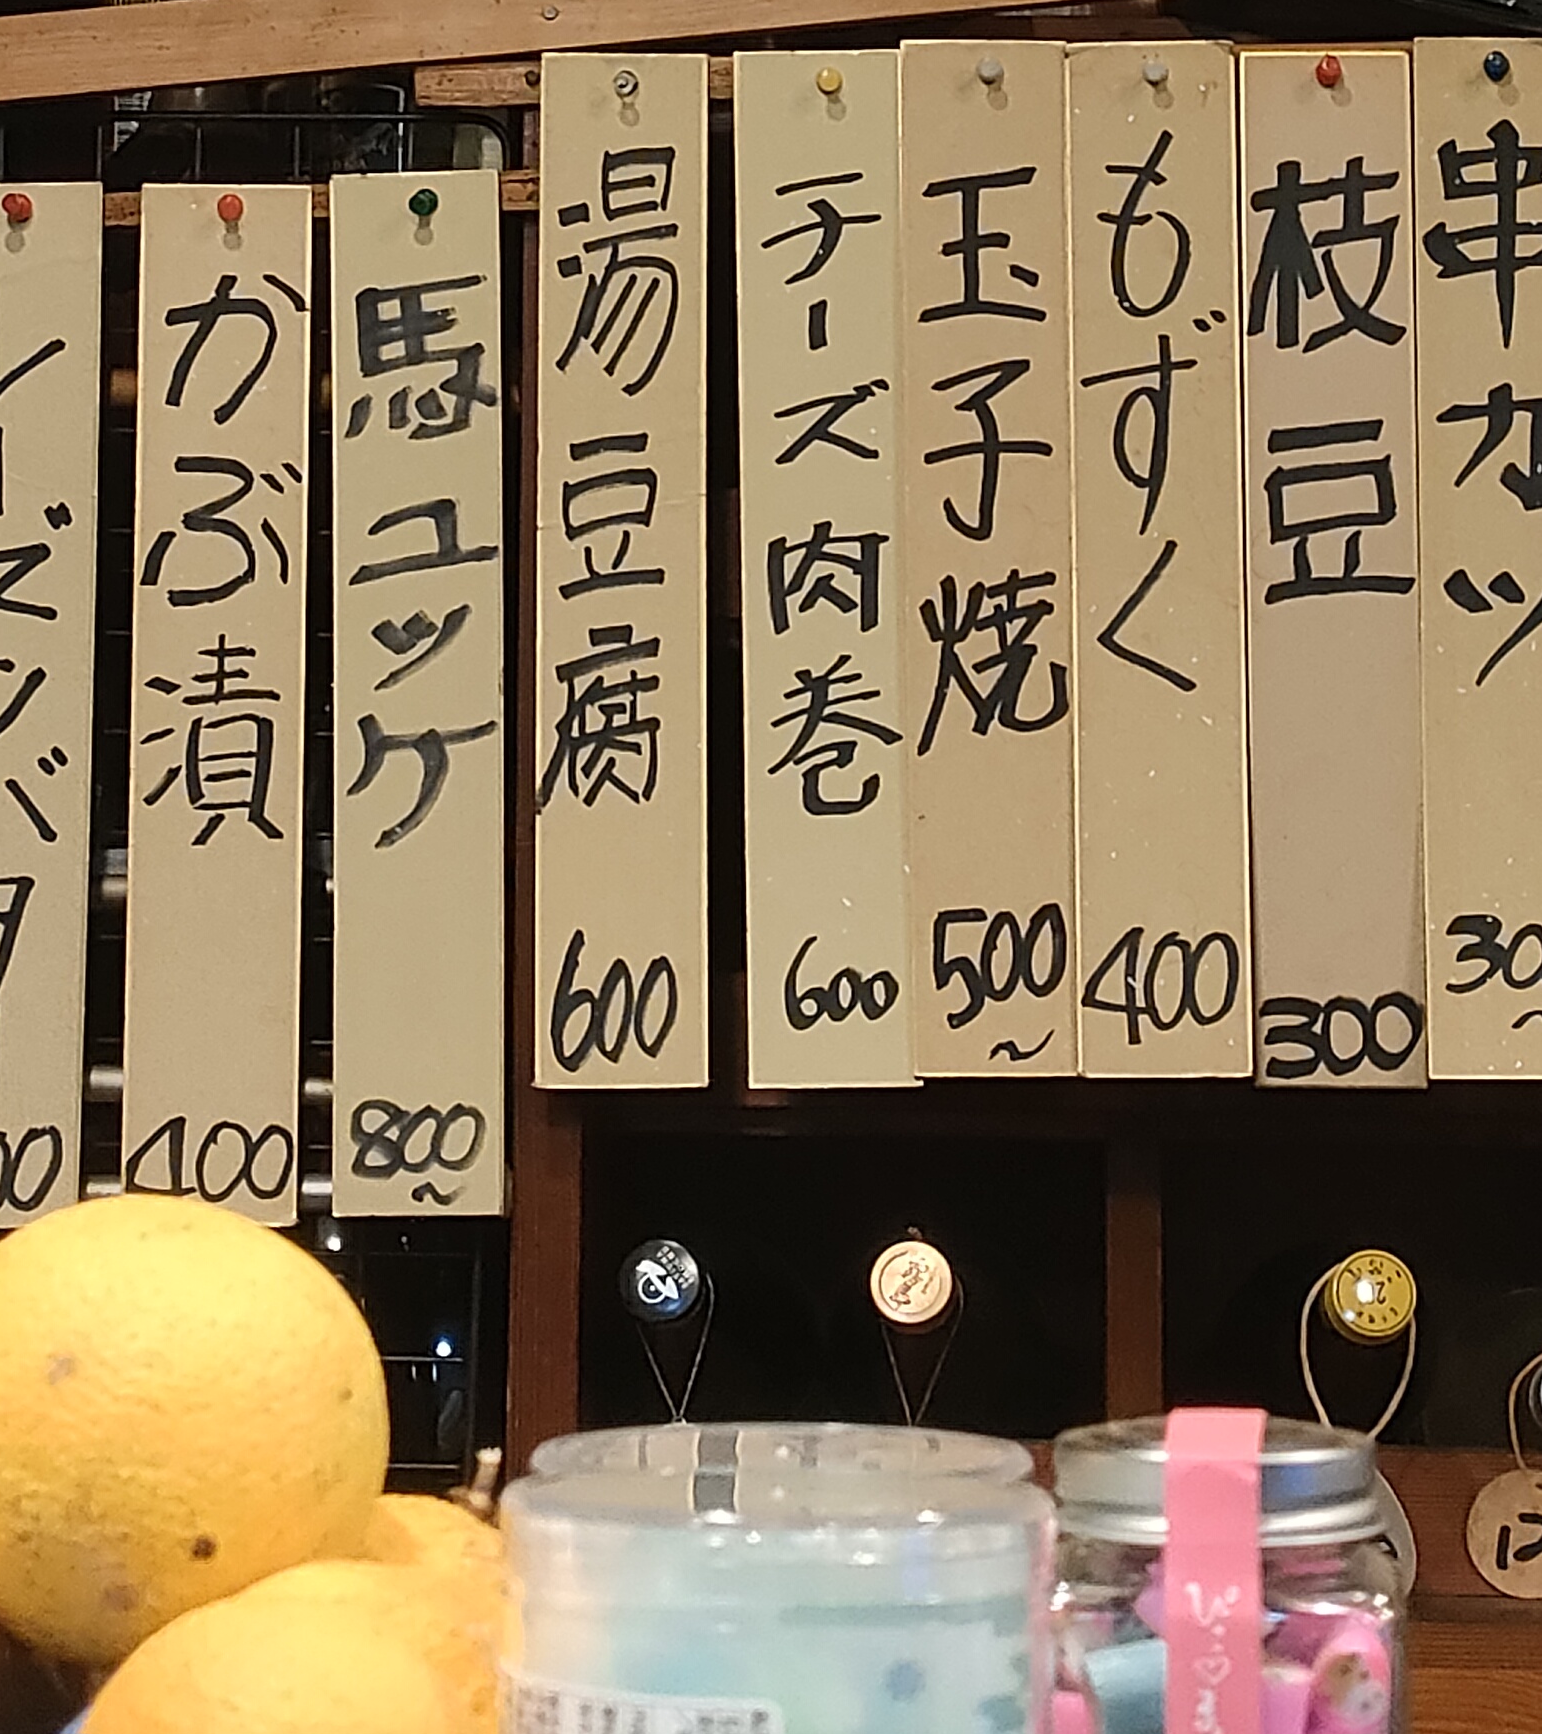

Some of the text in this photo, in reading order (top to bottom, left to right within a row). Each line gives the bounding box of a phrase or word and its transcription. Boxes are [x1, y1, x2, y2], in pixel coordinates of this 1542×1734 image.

[139, 271, 308, 847] かぶ漬
[344, 273, 499, 850] 馬ユッケ
[537, 146, 681, 815] 湯豆腐
[763, 172, 903, 816] チーズ肉巻
[916, 166, 1069, 757] 玉子焼
[1081, 128, 1227, 693] もずく
[1245, 156, 1416, 607] 枝豆
[125, 1116, 294, 1199] 400
[552, 929, 677, 1073] 600
[785, 935, 898, 1029] 600
[1081, 926, 1240, 1045] 400
[1263, 993, 1422, 1078] 300
